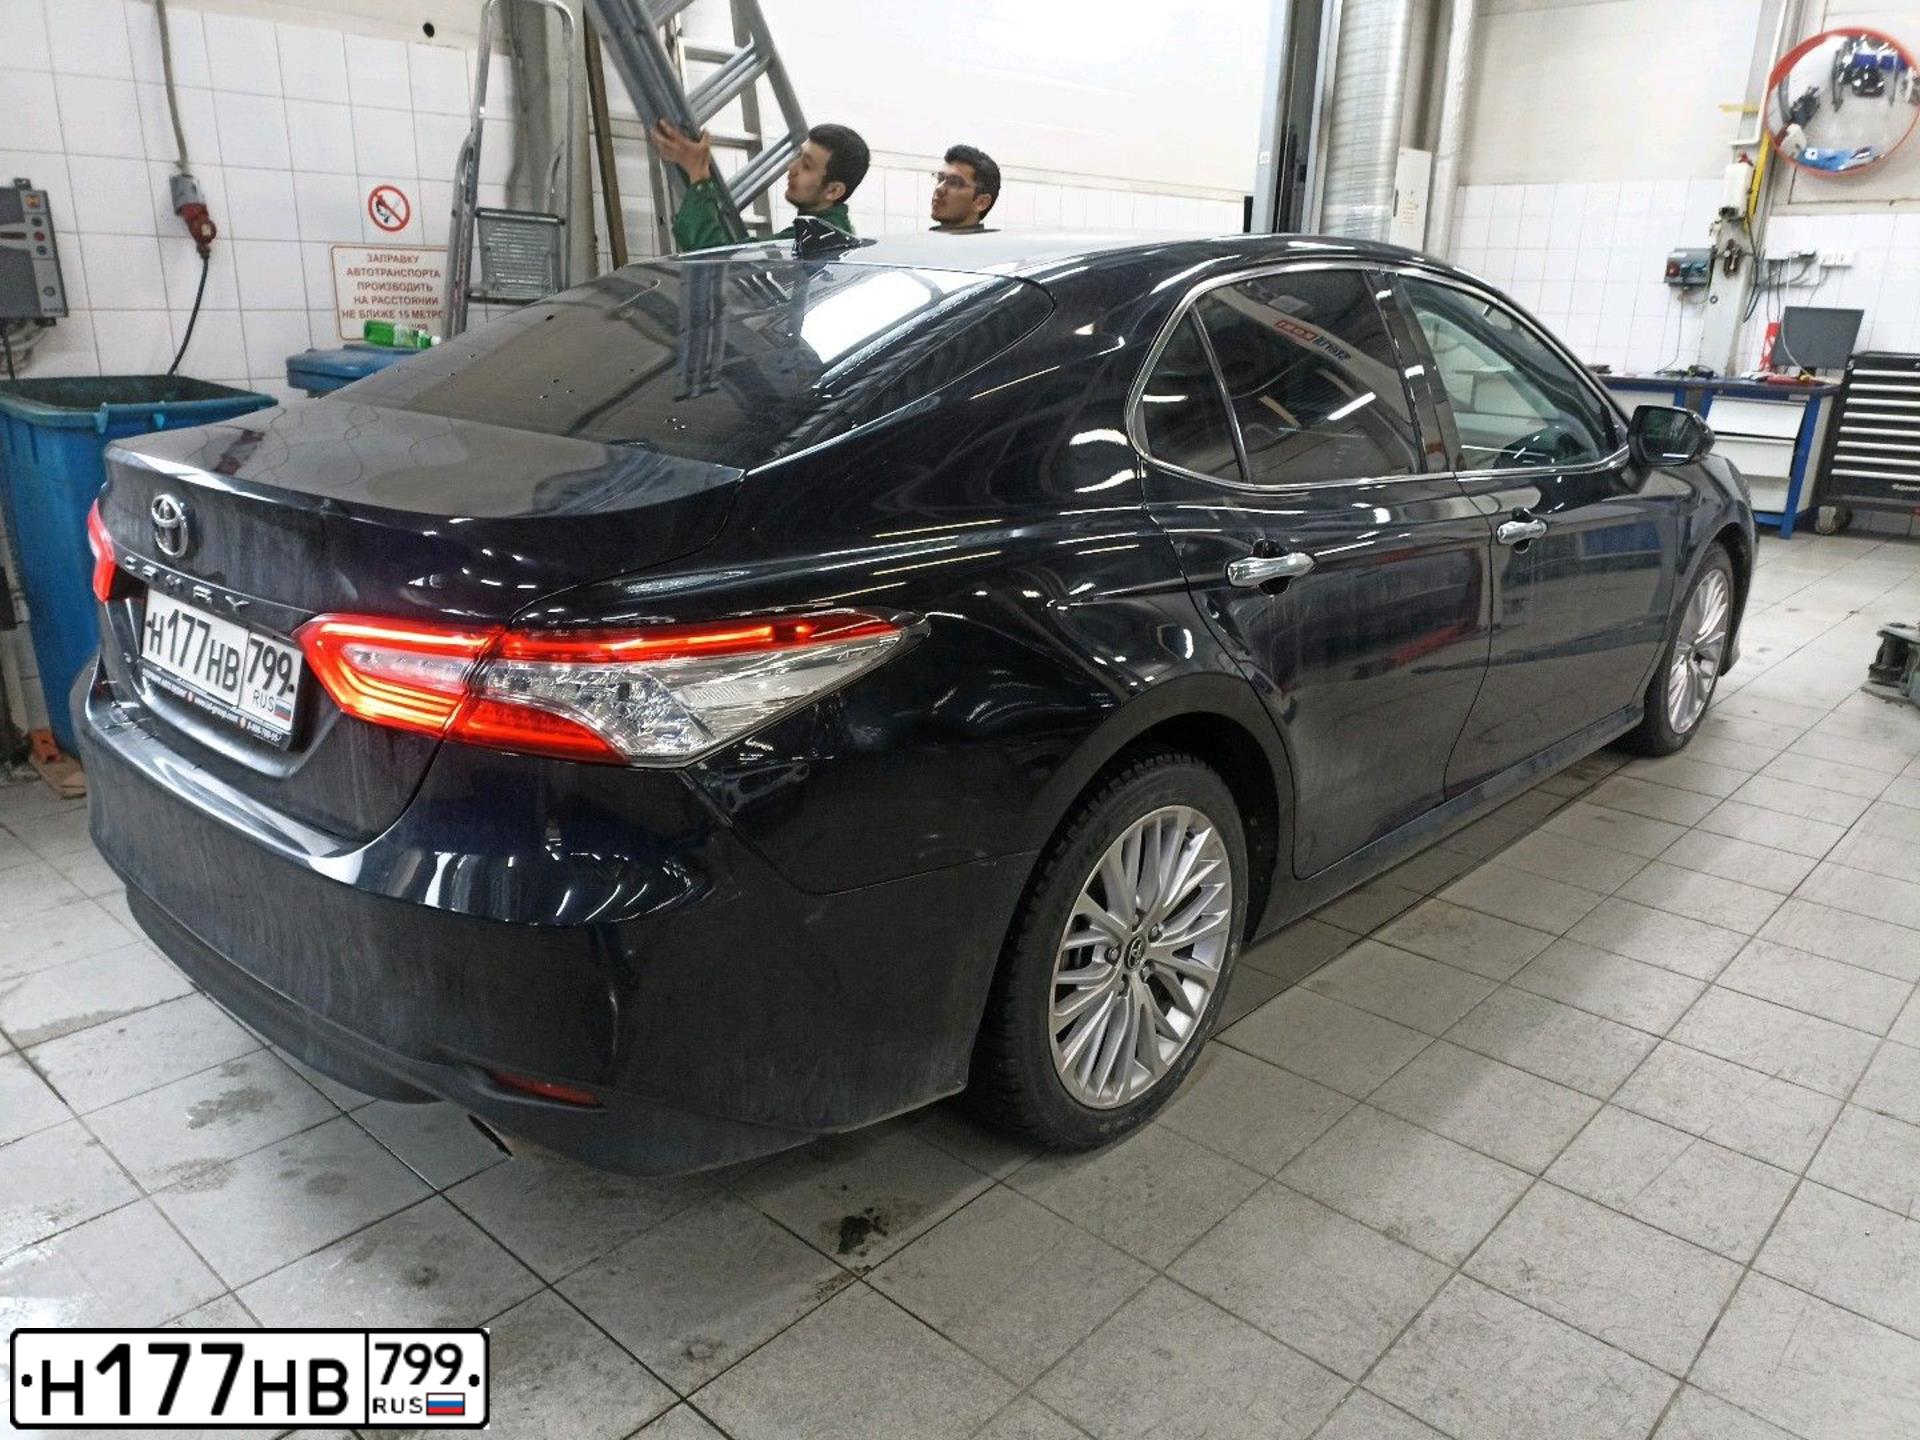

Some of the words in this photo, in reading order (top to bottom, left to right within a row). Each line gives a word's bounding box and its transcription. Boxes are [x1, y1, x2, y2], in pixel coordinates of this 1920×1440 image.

[367, 254, 419, 263] ЗАПРАВКУ
[346, 267, 441, 278] АВТОТРАНСПОРТА
[357, 281, 433, 292] ПРОИЗВОДИТЬ
[354, 296, 368, 304] НА
[371, 296, 439, 305] РАССТОЯНИИ
[342, 309, 356, 319] НЕ
[358, 310, 396, 319] БЛИЖЕ
[399, 310, 410, 319] 15
[247, 637, 293, 697] 799
[253, 689, 275, 712] RUS
